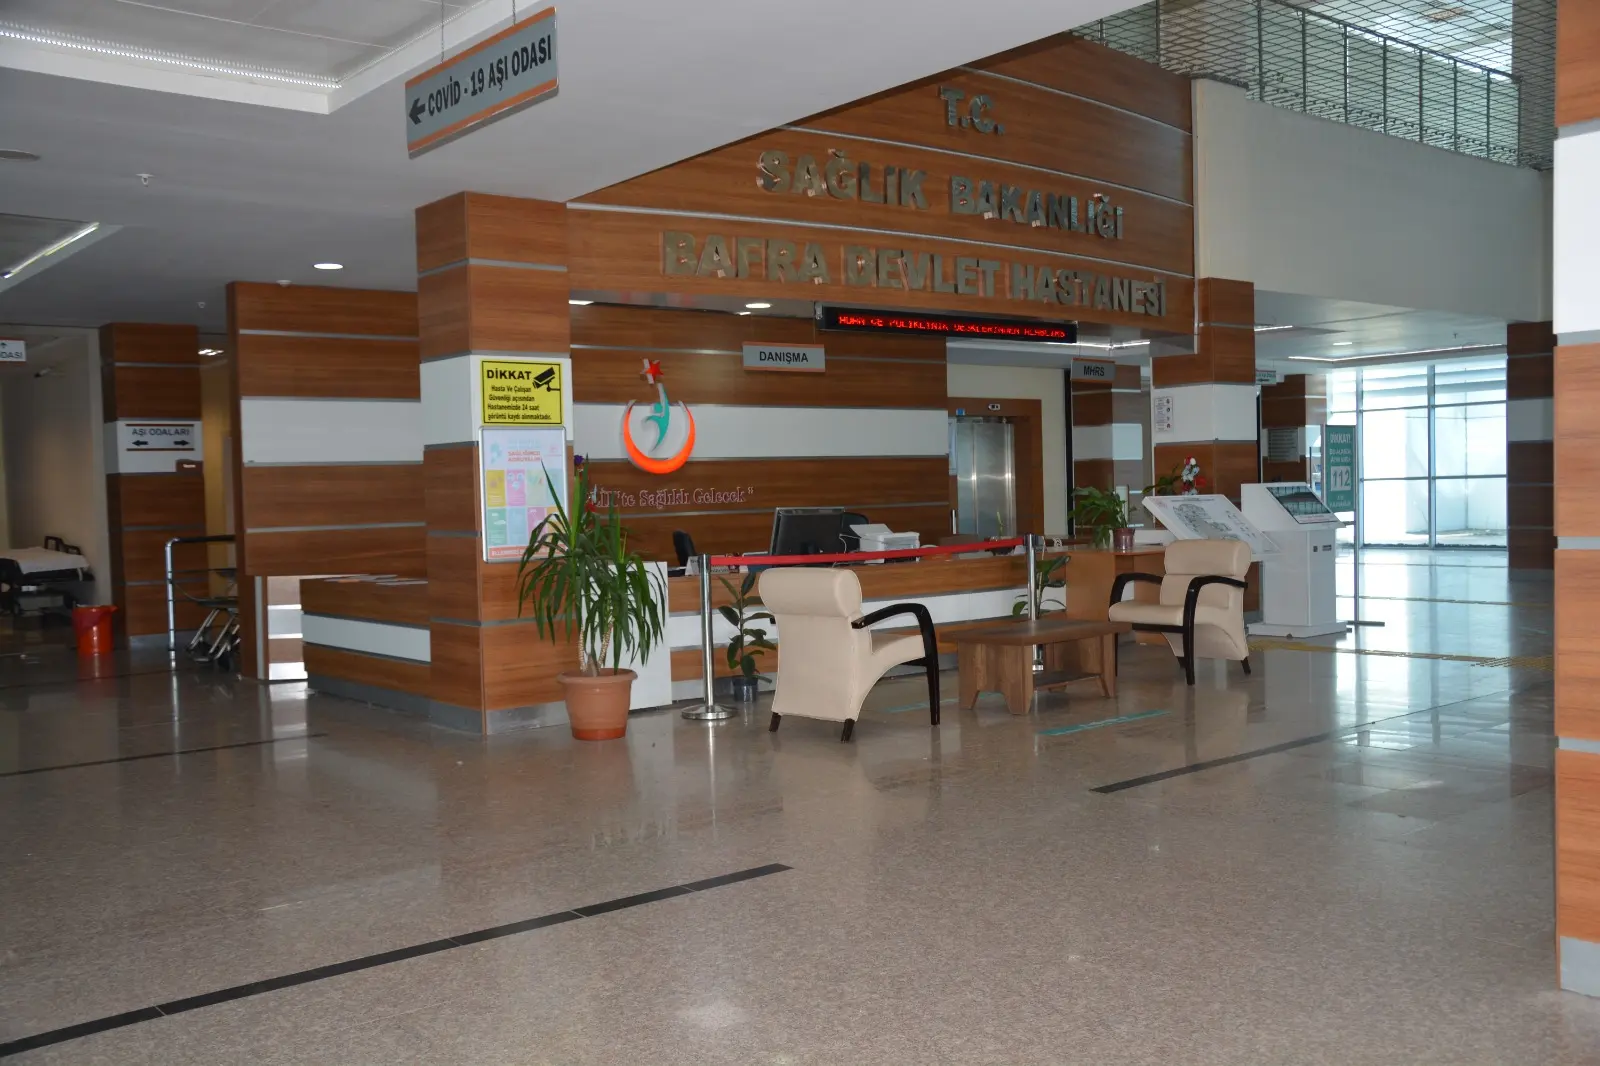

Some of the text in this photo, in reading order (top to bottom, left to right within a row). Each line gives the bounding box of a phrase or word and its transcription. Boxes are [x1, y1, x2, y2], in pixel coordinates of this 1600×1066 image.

[428, 76, 461, 117] COVİD
[470, 67, 485, 97] 19
[488, 55, 509, 91] AŞI
[511, 34, 552, 77] ODASI
[939, 85, 1005, 135] T.C.
[756, 148, 1124, 240] SAĞLIK BAKANLIĞI
[662, 229, 1167, 317] BAFRA DEVLET HASTANESİ
[759, 350, 809, 365] DANIŞMA
[486, 367, 532, 380] DİKKAT
[1083, 365, 1105, 377] MHRS
[132, 427, 190, 437] AŞI ODALARI
[1331, 468, 1351, 488] 112
[639, 487, 691, 510] Sağlıklı
[693, 486, 746, 505] Gelecek
